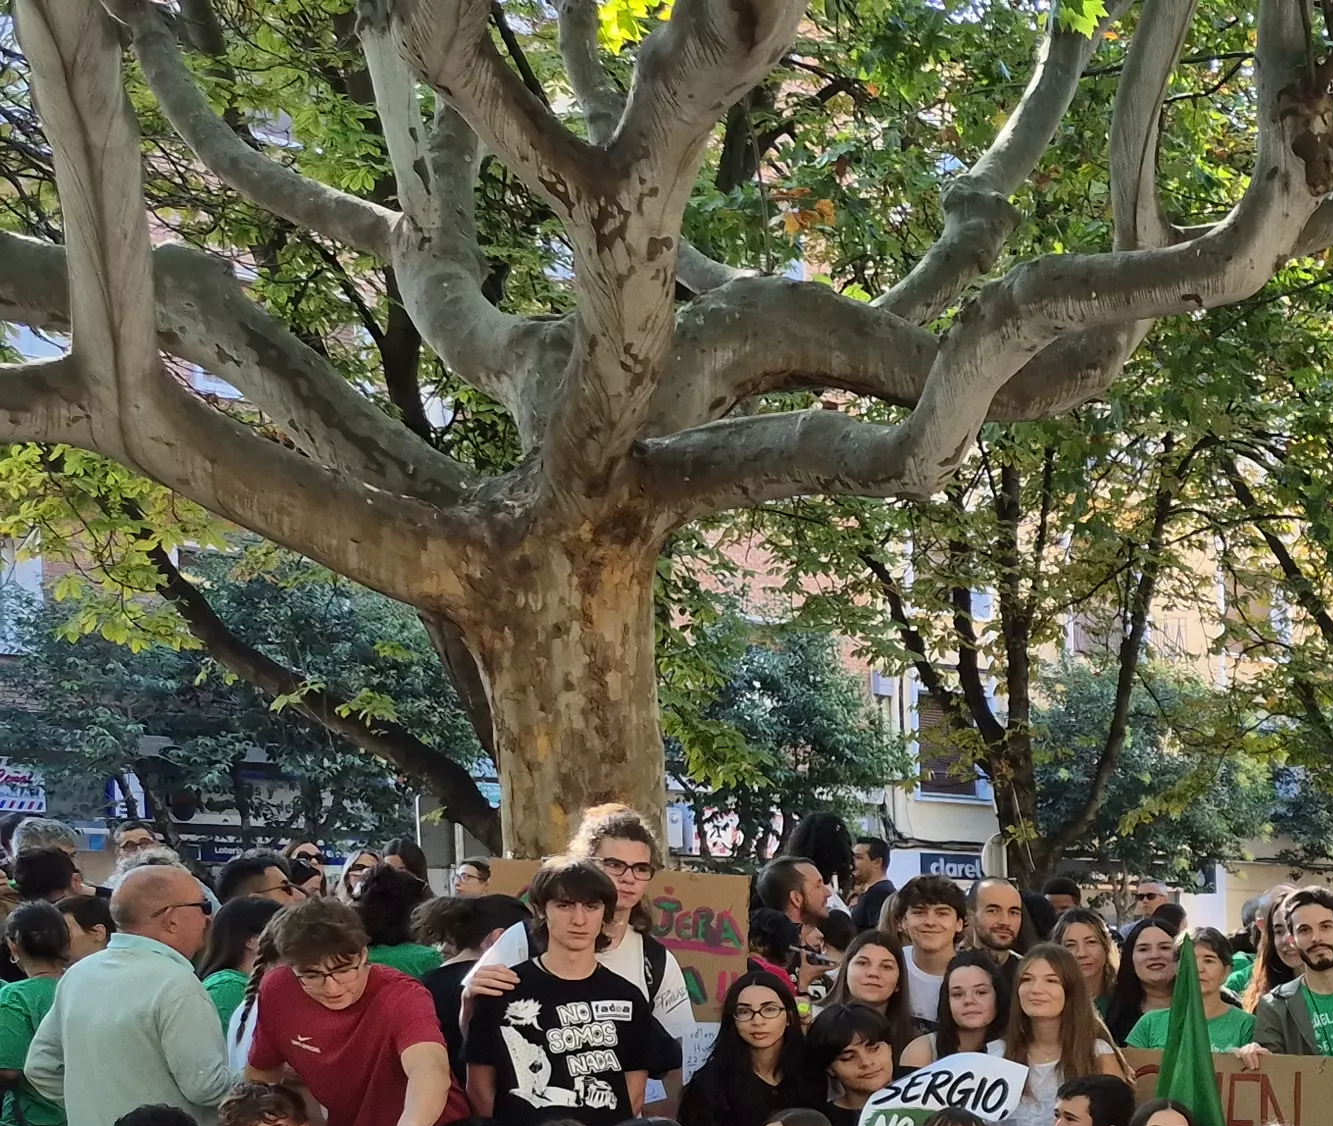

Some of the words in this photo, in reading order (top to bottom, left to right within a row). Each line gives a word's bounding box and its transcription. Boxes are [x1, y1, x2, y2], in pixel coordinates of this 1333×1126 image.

[931, 859, 982, 879] clarel
[556, 1002, 592, 1025] NO
[546, 1022, 618, 1053] SOMOS
[567, 1050, 621, 1077] NADA
[872, 1070, 1010, 1120] SERGIO,
